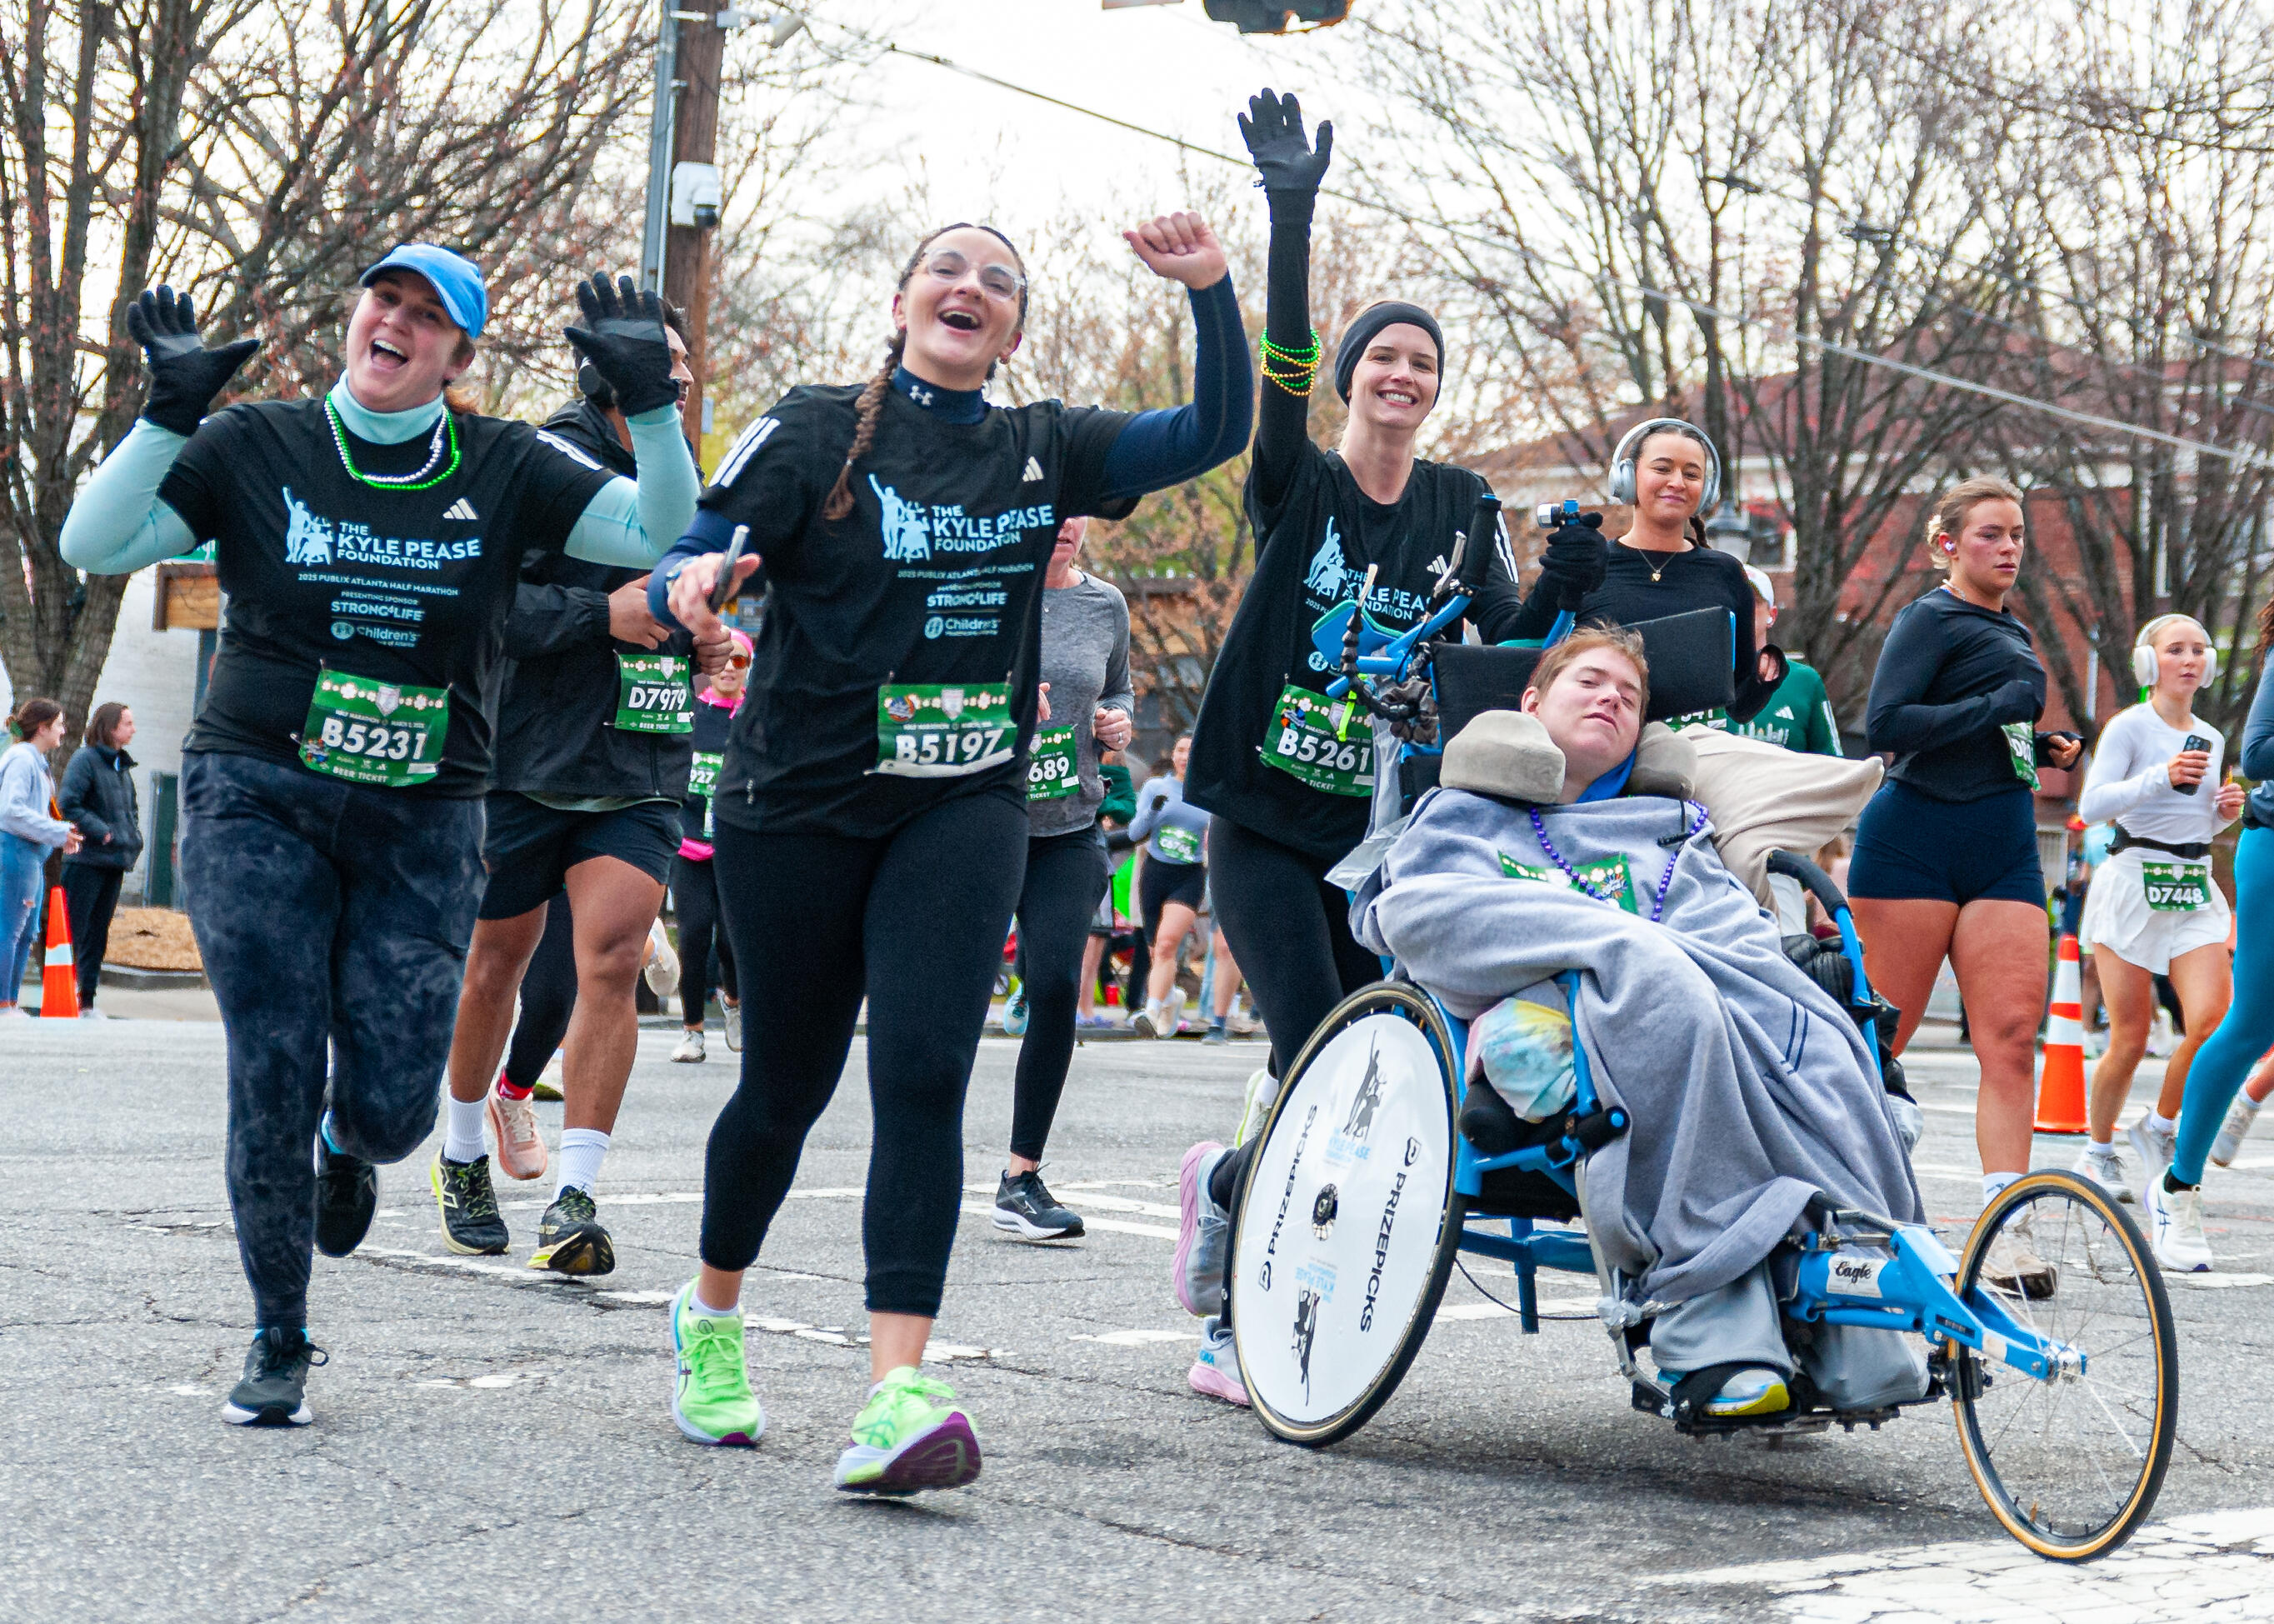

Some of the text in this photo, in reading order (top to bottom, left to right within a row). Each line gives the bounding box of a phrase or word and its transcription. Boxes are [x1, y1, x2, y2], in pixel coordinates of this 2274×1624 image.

[931, 504, 963, 517] THE
[932, 504, 1055, 538] KYLE PEASE
[339, 522, 369, 536] THE
[934, 530, 1022, 552] FOUNDATON
[337, 532, 482, 560] KYLE PEASE
[337, 548, 440, 571] FOUNDATION
[297, 573, 459, 597] 2025 PUBLIX ATLANTA HALF MARATHON
[341, 590, 419, 606] PRESENTING SPONSOR
[1342, 588, 1413, 621] FONDATION
[1392, 587, 1432, 612] PEA
[357, 625, 419, 642] Children's
[628, 686, 687, 711] D7979
[320, 717, 427, 761] B5231
[896, 728, 1004, 765] B5197
[1277, 727, 1371, 772] B5261
[332, 766, 388, 783] BEER TICKET
[1309, 779, 1335, 791] TICKET
[2147, 886, 2205, 904] D7448
[1267, 1104, 1317, 1256] PRIZEPICKS
[1359, 1172, 1407, 1333] PRIZEPICKS
[1835, 1261, 1872, 1284] Eagle
